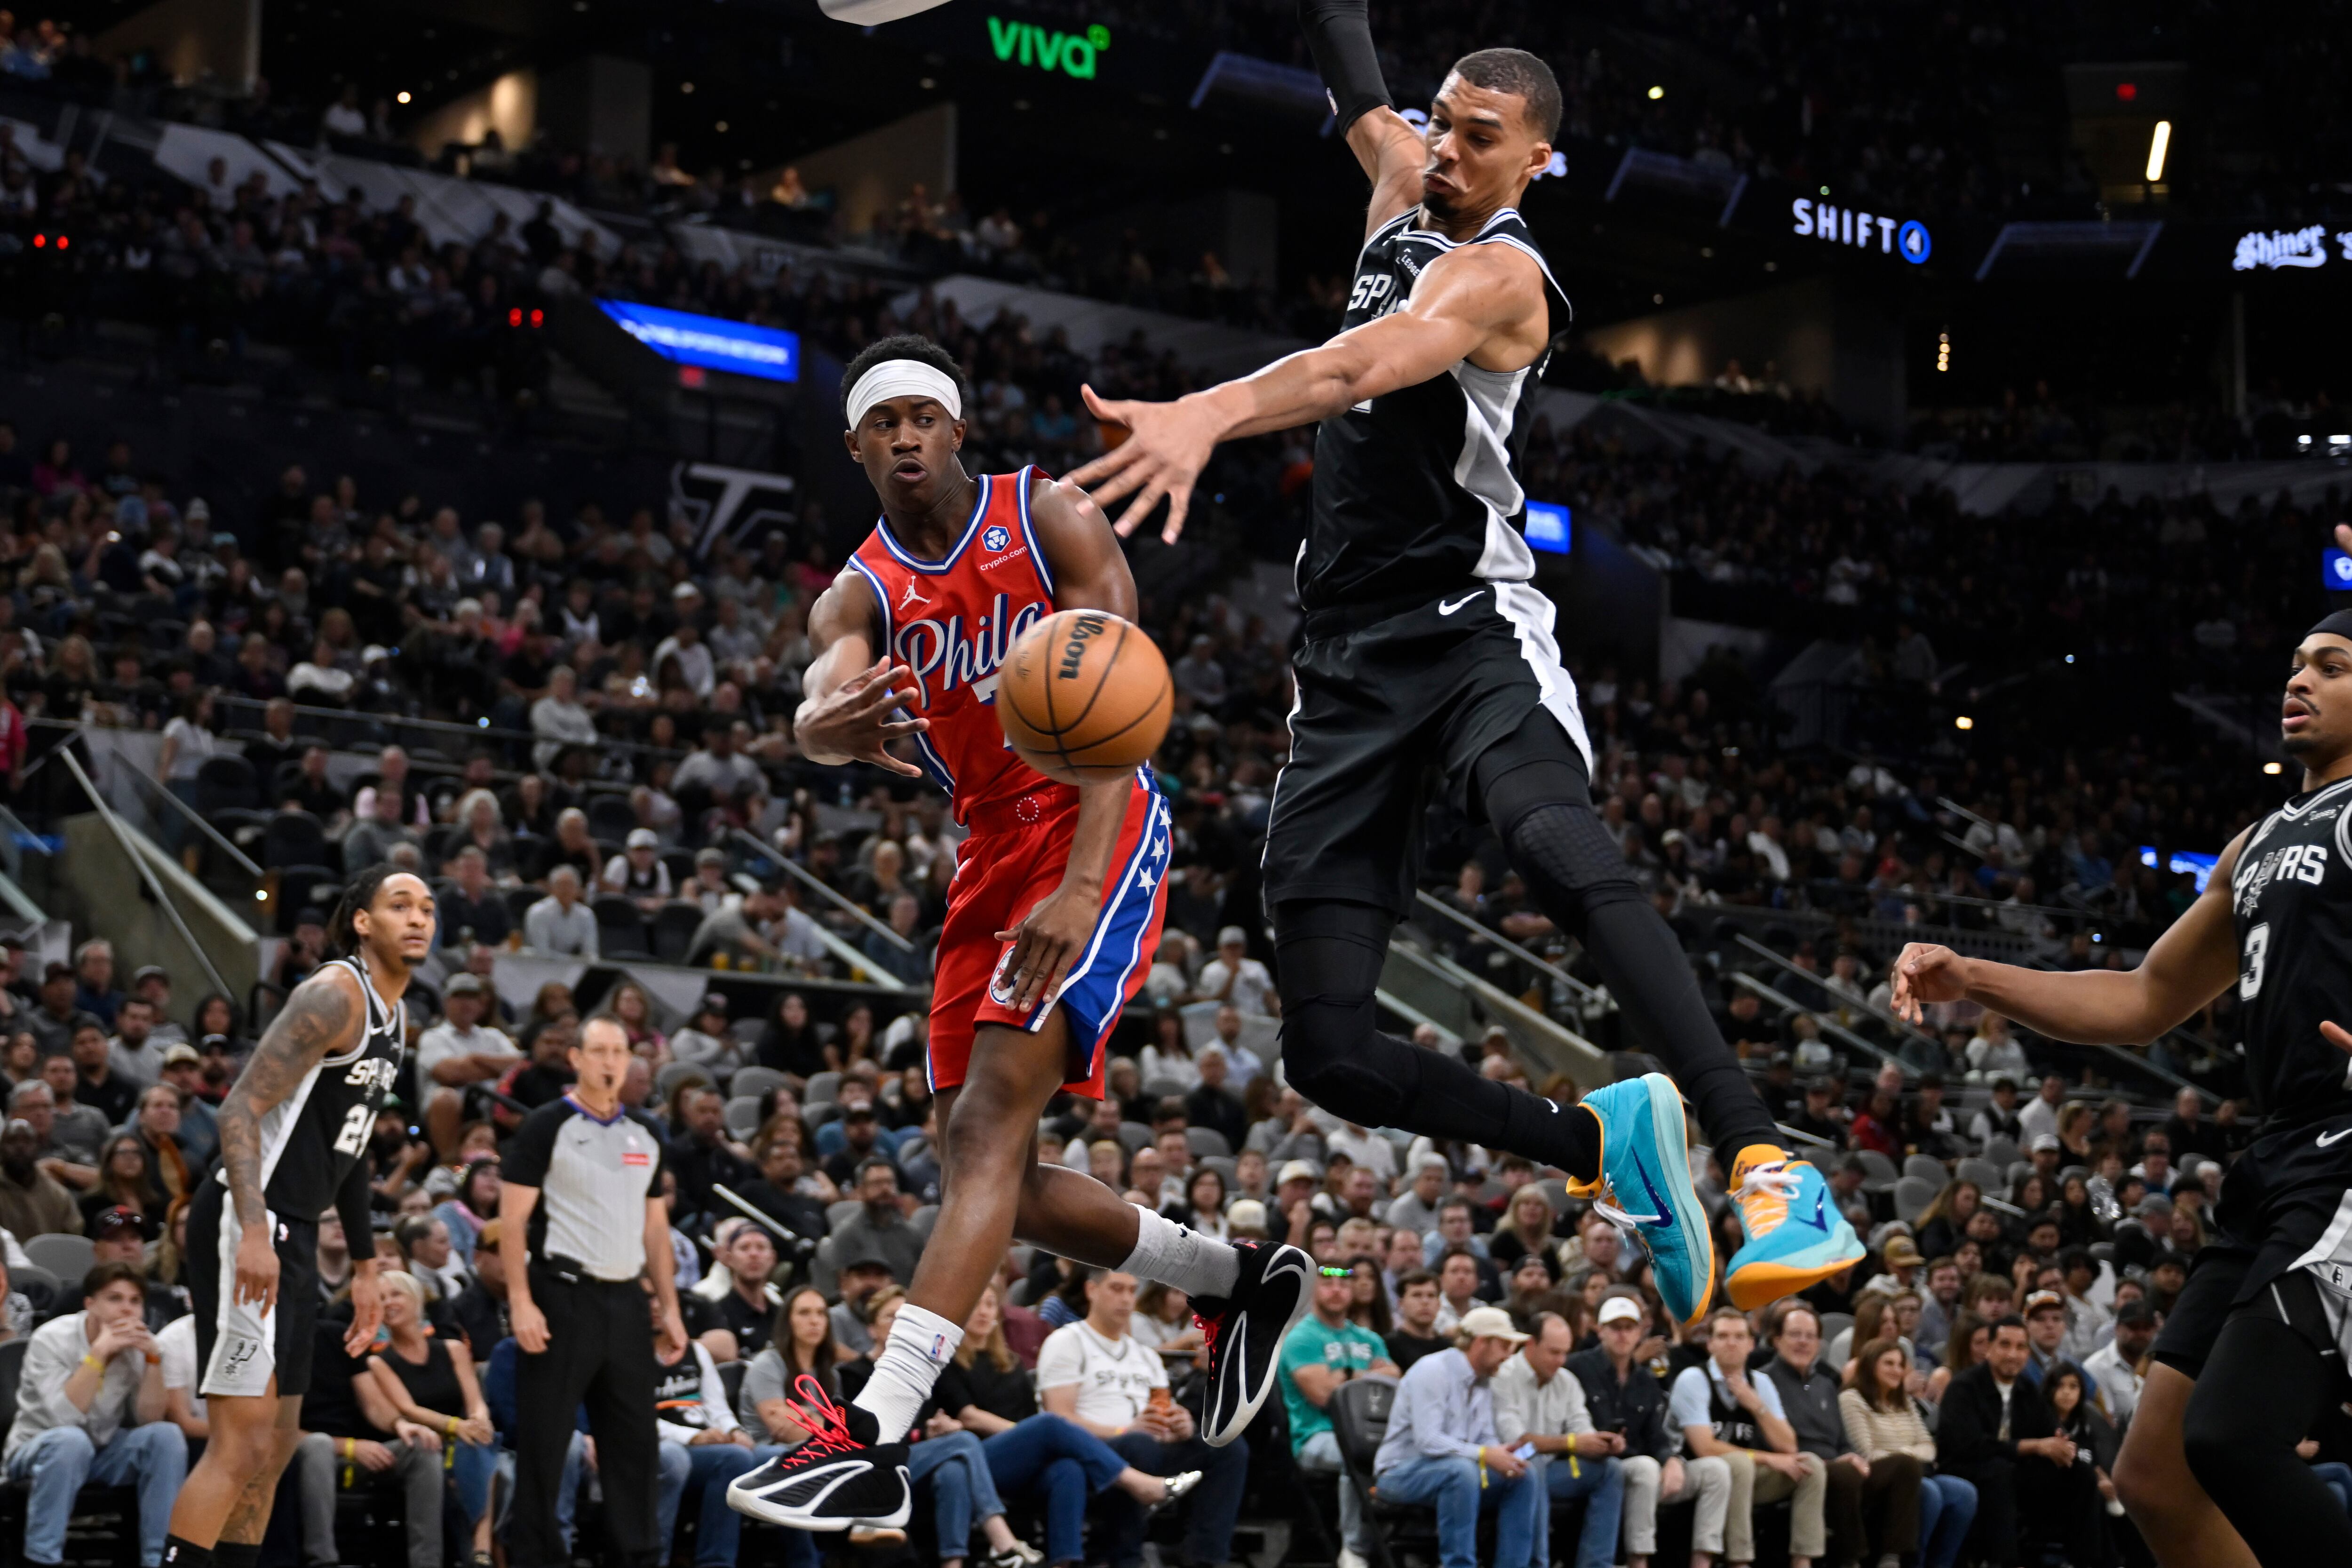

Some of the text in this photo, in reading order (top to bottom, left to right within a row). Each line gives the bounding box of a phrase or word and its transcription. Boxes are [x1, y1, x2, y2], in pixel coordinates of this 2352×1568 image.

[2233, 224, 2327, 270] Shiner
[1401, 255, 1421, 278] LEDGE
[980, 546, 1027, 571] crypto.com
[2239, 921, 2270, 1001] 3
